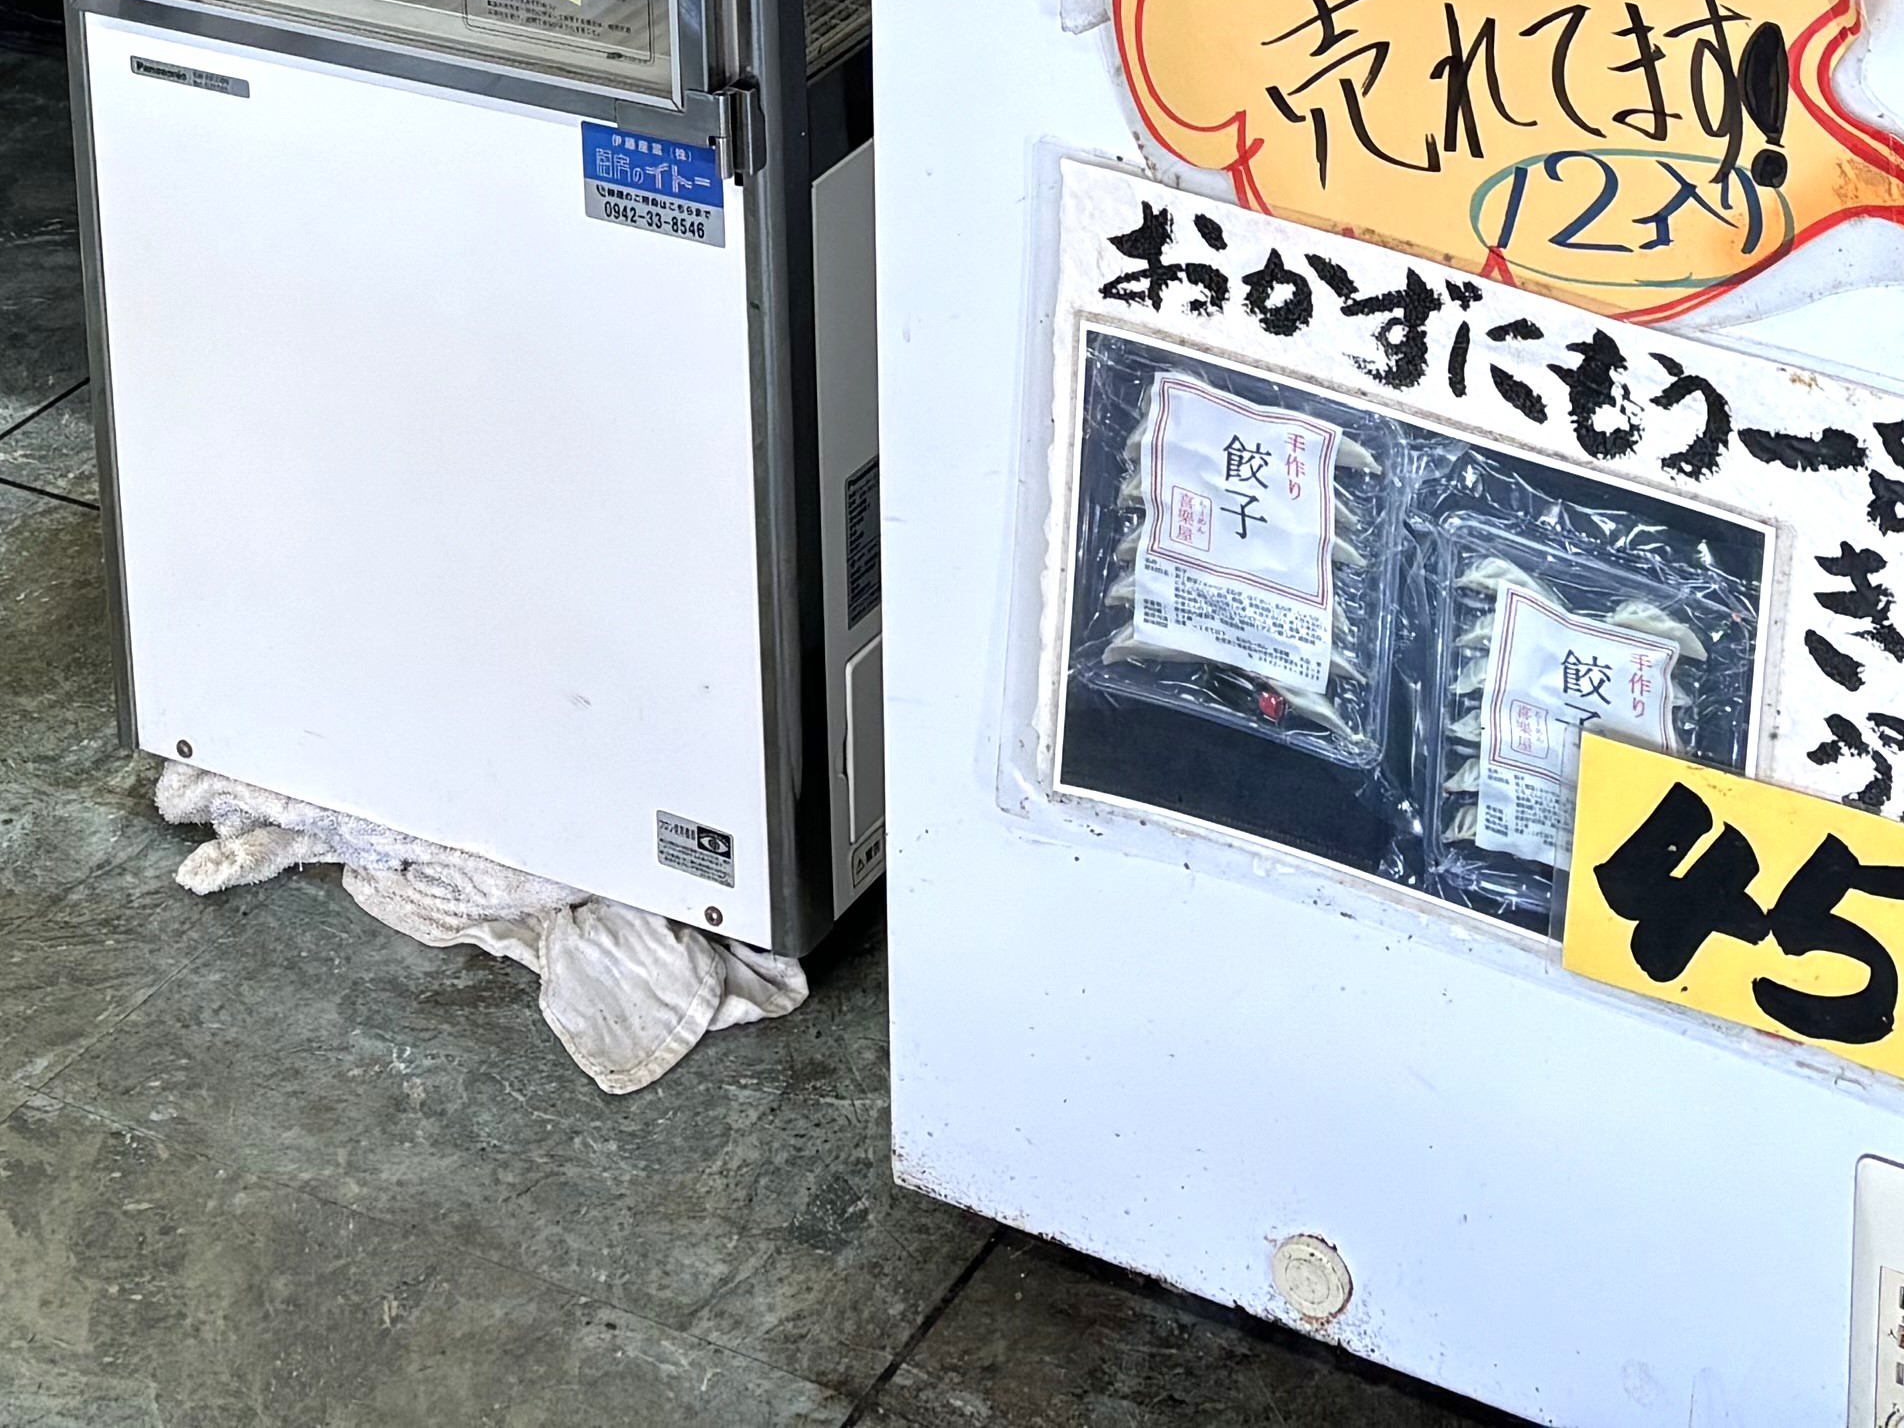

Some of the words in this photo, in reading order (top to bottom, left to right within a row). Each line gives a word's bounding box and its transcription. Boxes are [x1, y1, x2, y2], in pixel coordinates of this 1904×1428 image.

[604, 201, 706, 240] 0942-33-8546
[1220, 434, 1273, 540] 餃子
[1284, 433, 1306, 500] 手作り
[1629, 652, 1652, 718] 手作り
